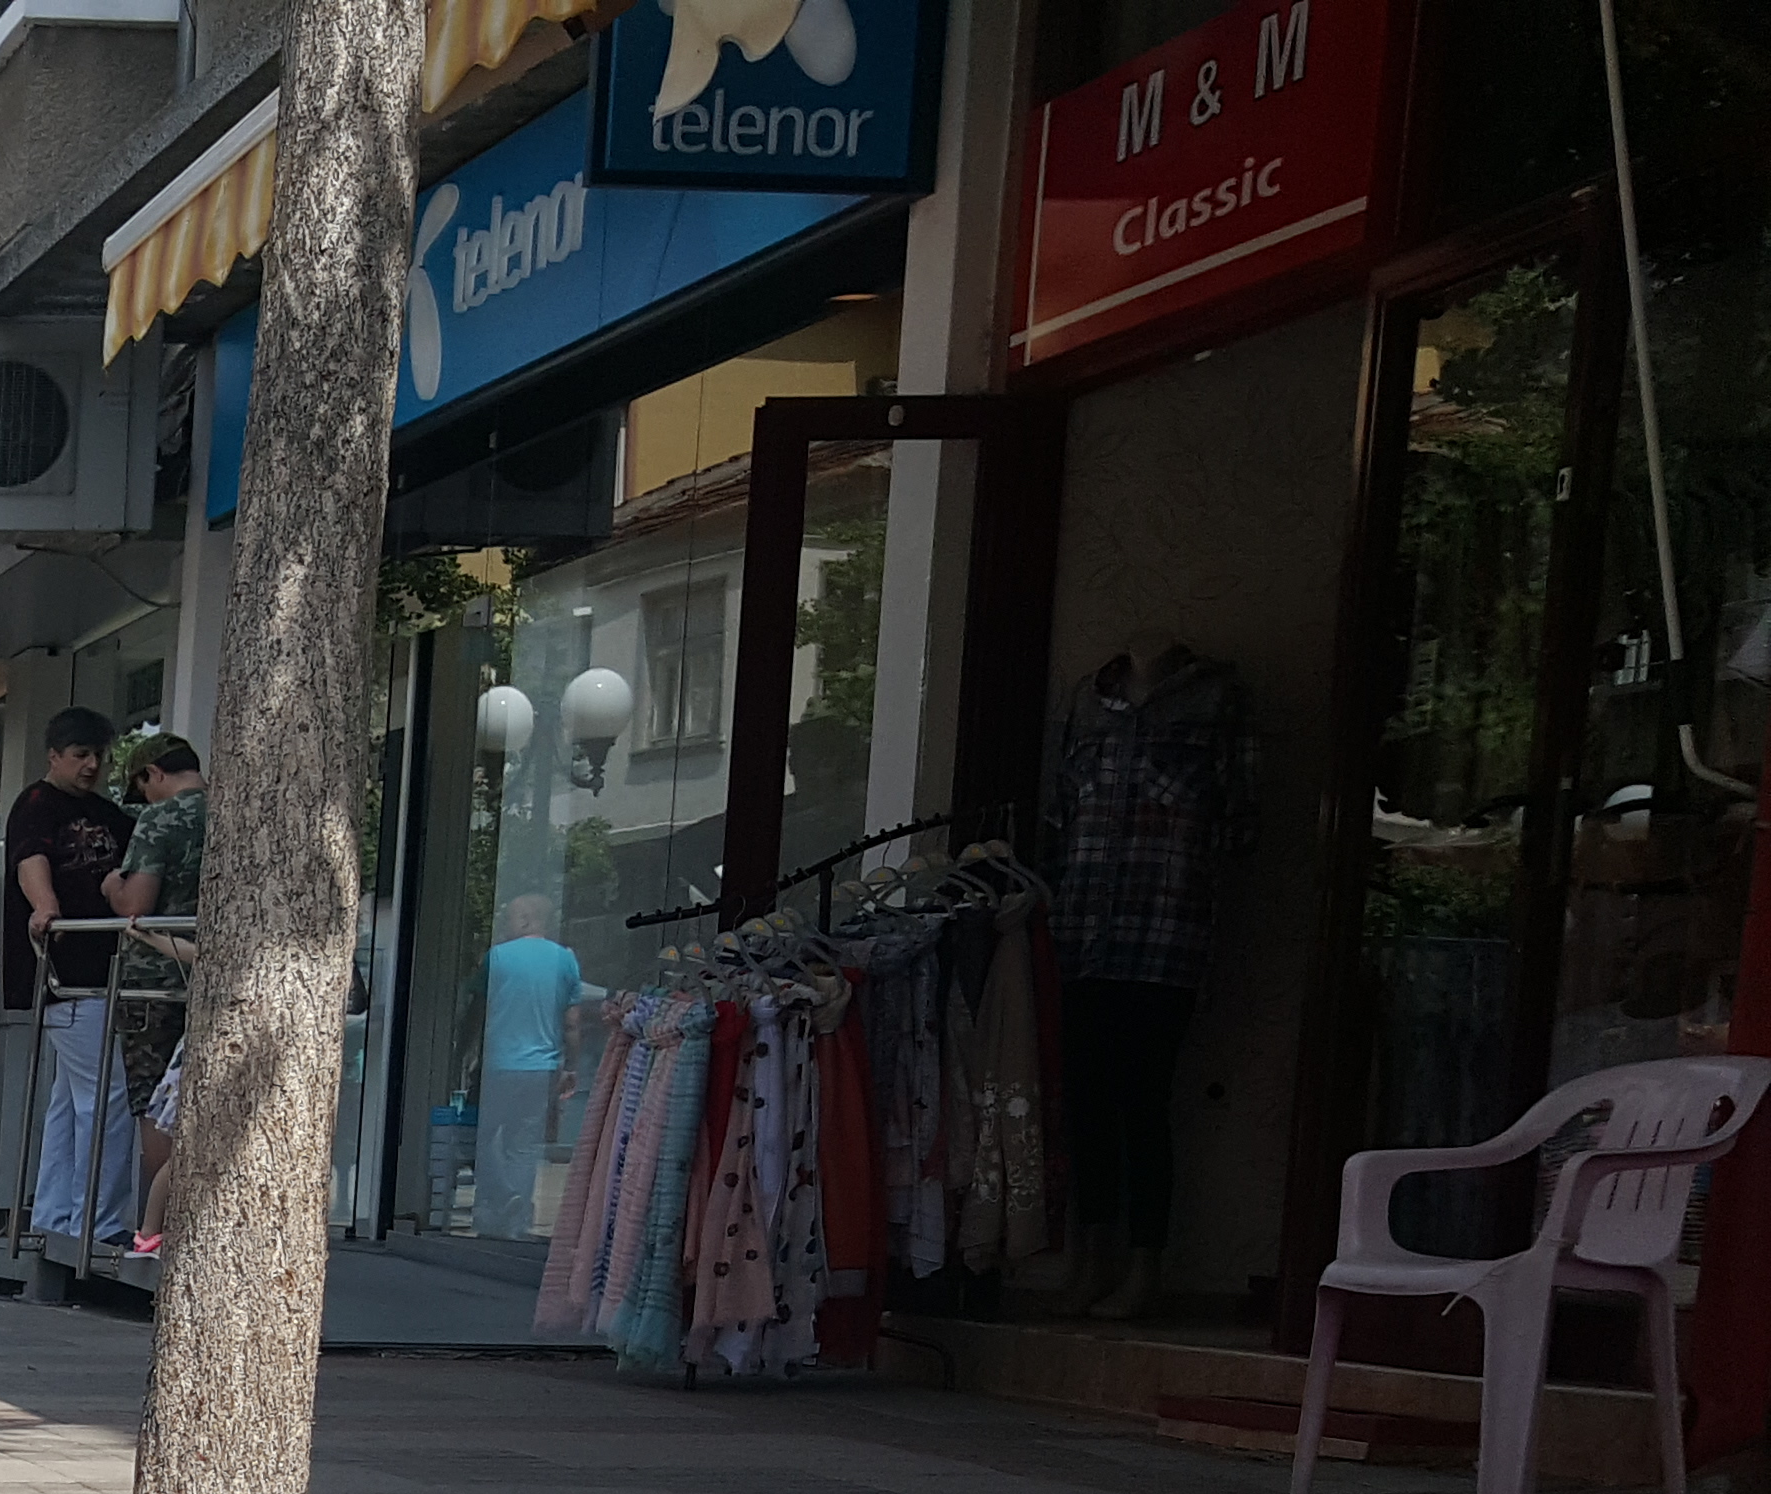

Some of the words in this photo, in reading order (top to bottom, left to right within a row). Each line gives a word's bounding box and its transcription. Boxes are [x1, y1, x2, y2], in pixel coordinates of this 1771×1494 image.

[648, 88, 874, 158] telenor
[1117, 69, 1165, 163] M
[1189, 59, 1222, 126] &
[1254, 0, 1309, 99] M
[453, 171, 586, 313] telenor
[1113, 156, 1284, 256] Classic
